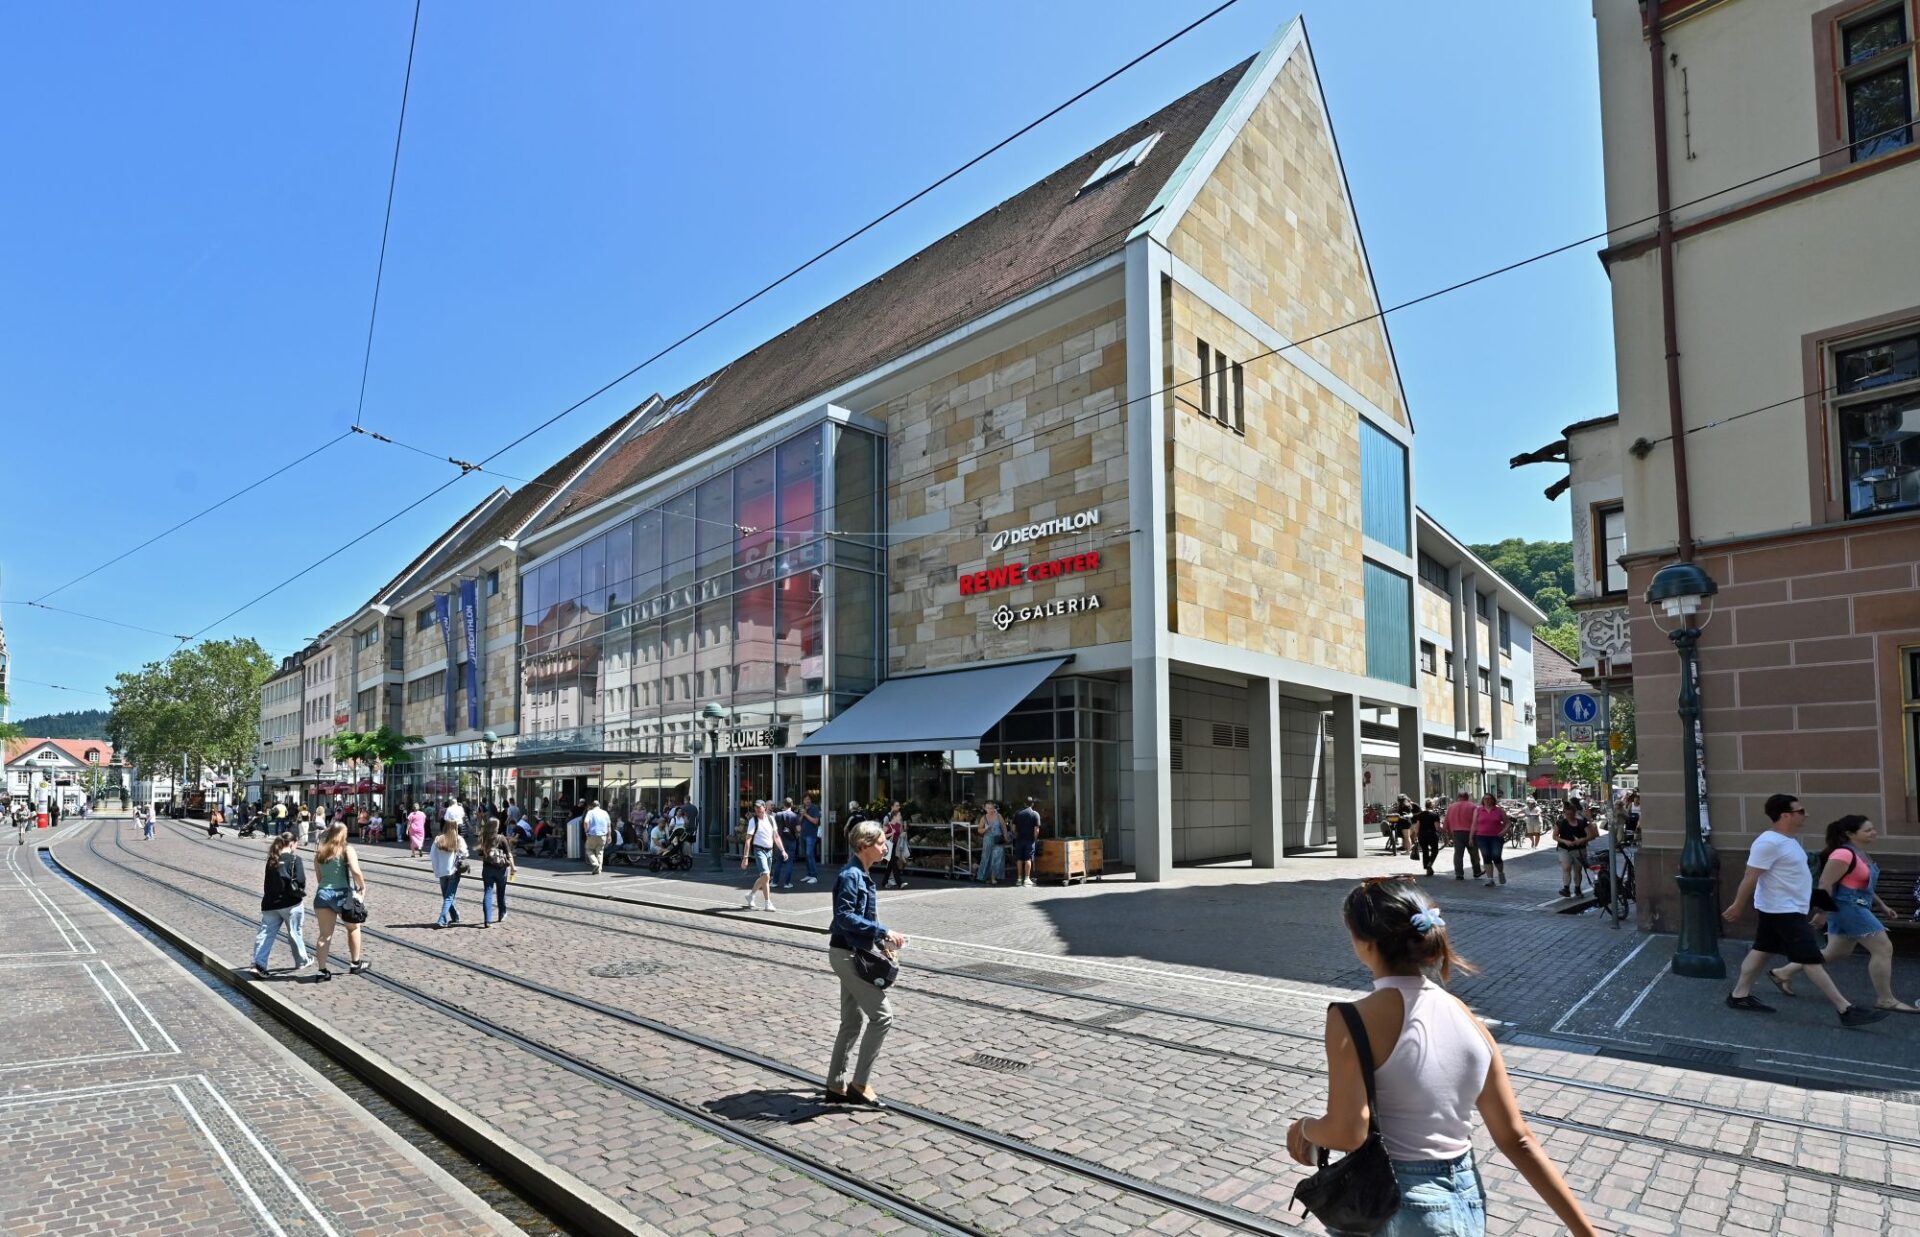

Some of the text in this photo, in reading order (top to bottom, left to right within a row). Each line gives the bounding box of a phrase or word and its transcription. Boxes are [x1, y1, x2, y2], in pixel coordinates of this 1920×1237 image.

[1010, 509, 1100, 545] DECATHLON
[744, 530, 815, 580] SALE
[959, 551, 1101, 596] REWE CENTER
[1019, 594, 1100, 621] GALERIA
[465, 604, 476, 653] DECATHLON
[724, 730, 764, 748] BLUME
